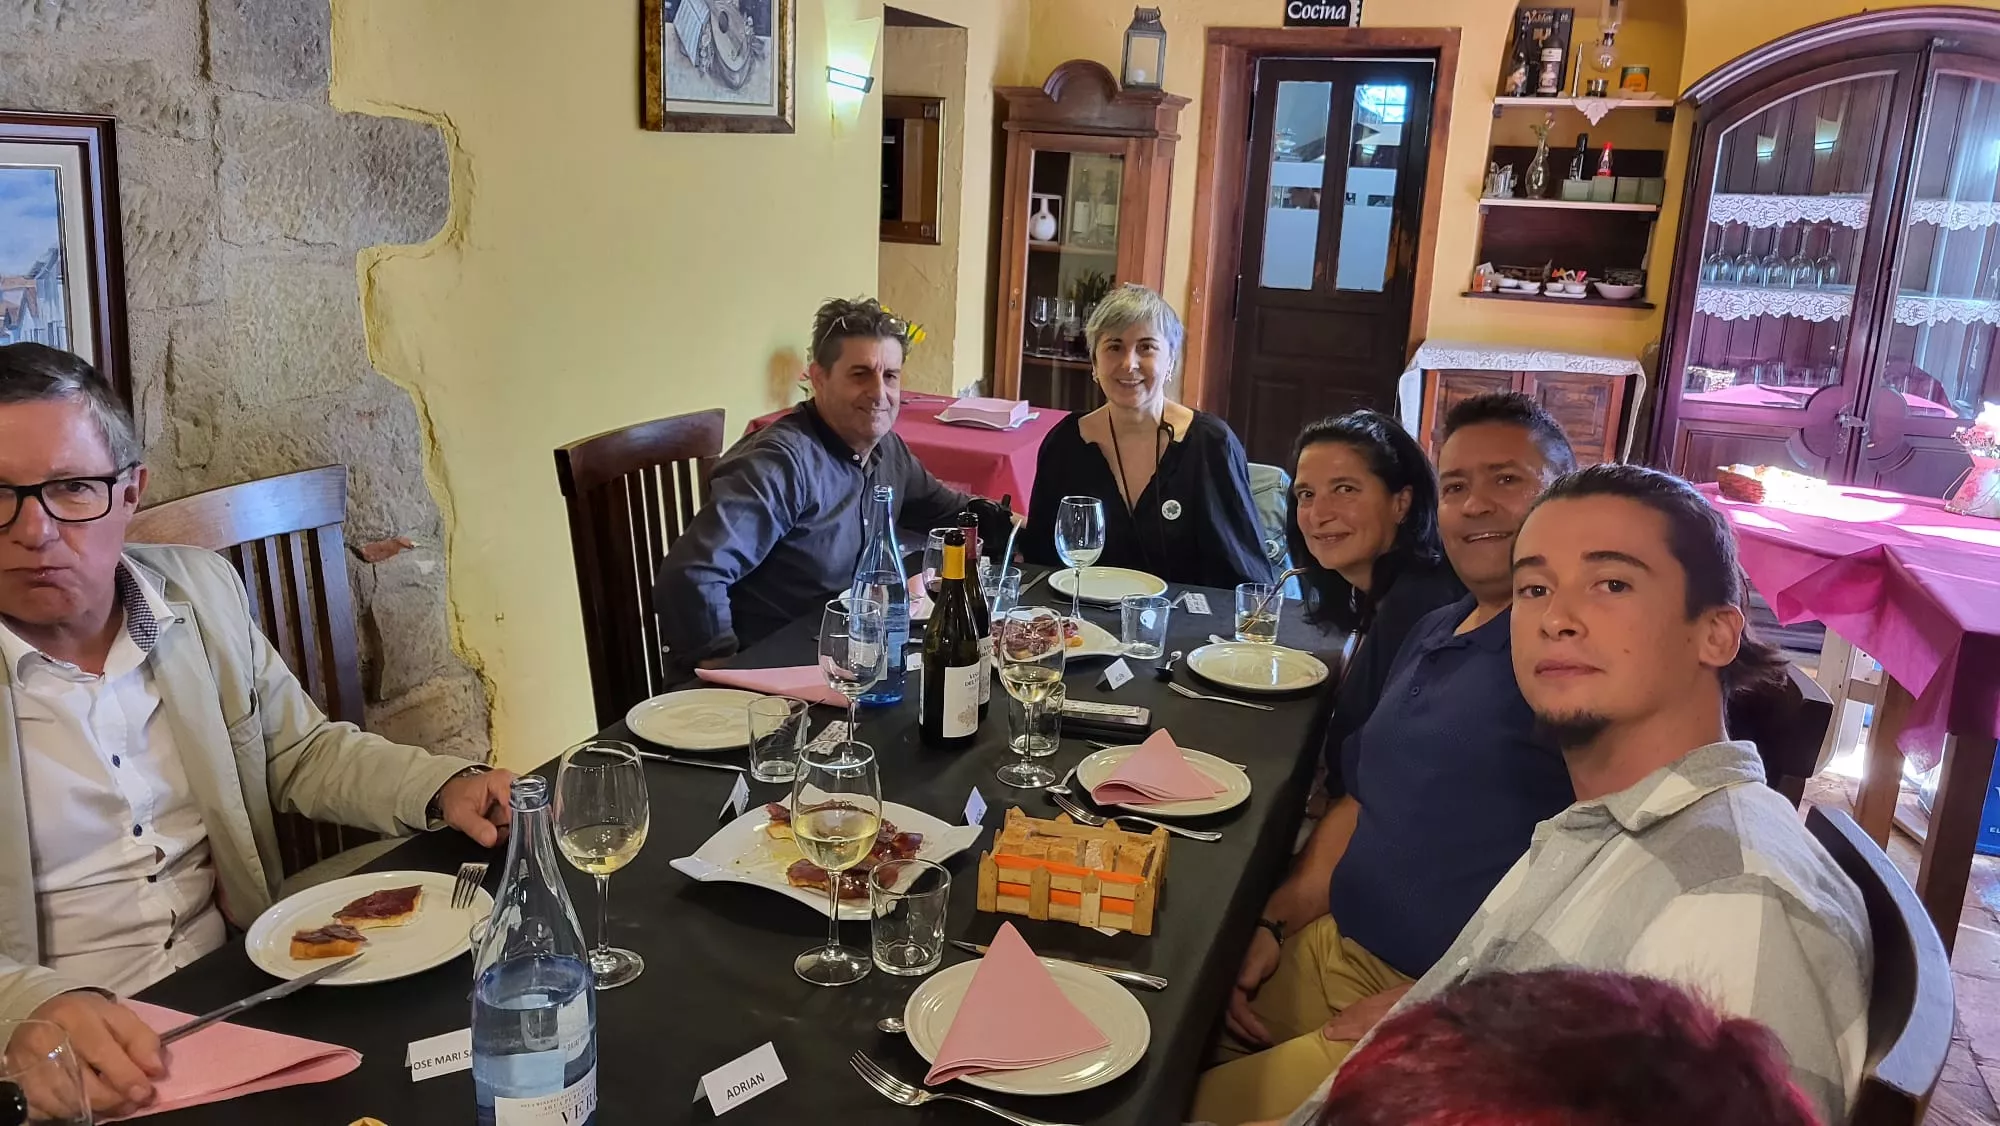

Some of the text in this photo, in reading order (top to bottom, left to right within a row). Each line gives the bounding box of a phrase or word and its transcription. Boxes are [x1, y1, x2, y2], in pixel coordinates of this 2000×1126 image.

[1287, 0, 1347, 19] Cocina
[413, 1059, 432, 1070] OSE
[434, 1051, 461, 1065] MARI
[726, 1073, 765, 1100] ADRIAN
